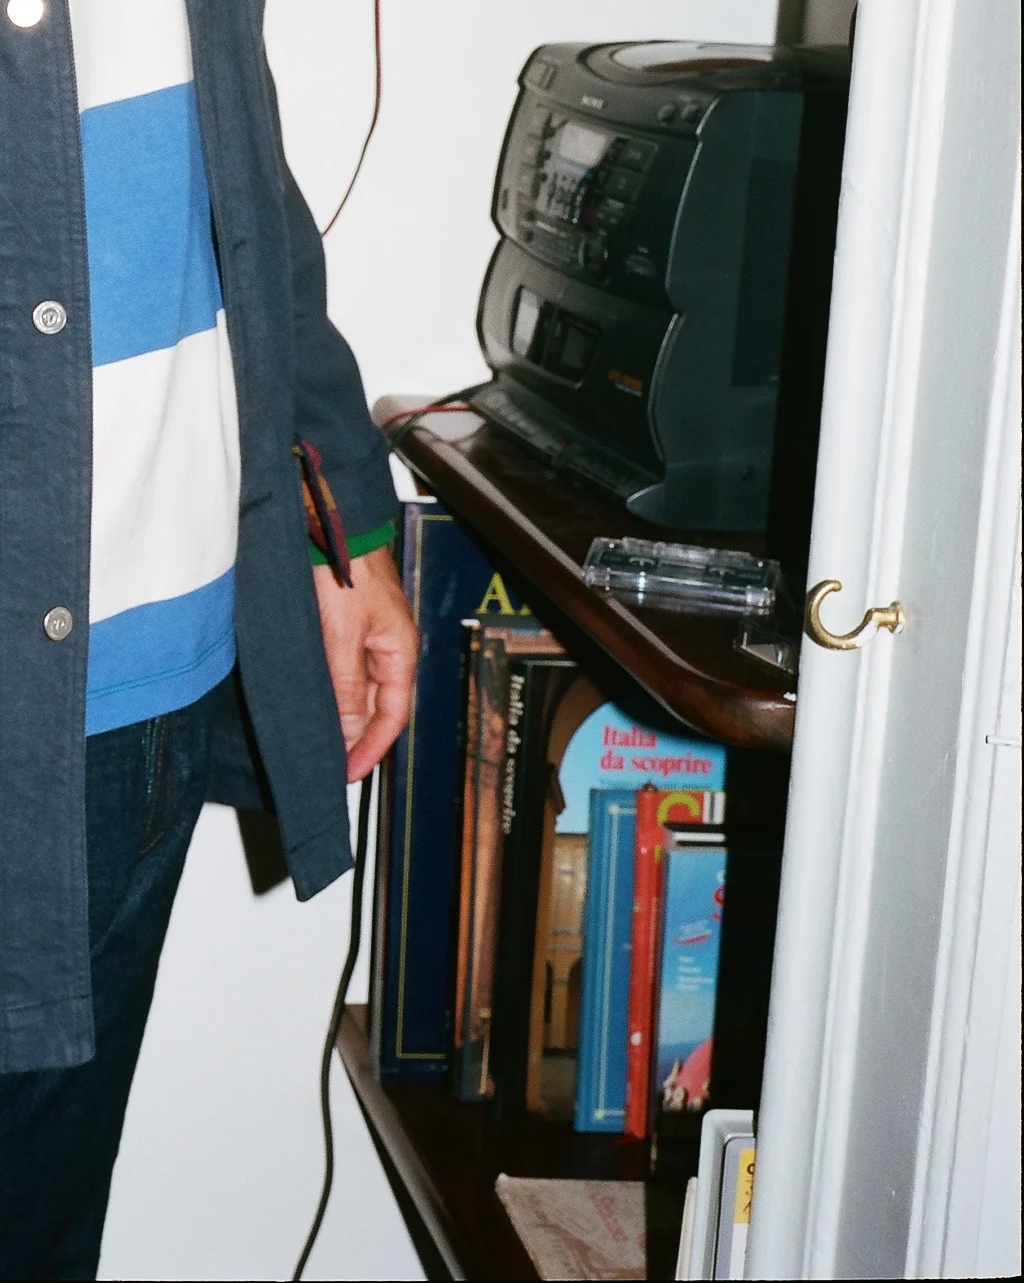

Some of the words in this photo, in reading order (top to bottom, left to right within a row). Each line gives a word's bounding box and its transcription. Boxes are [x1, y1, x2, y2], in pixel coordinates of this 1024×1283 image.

[602, 724, 658, 749] Italia
[599, 749, 625, 771] da
[631, 750, 714, 779] scoprire
